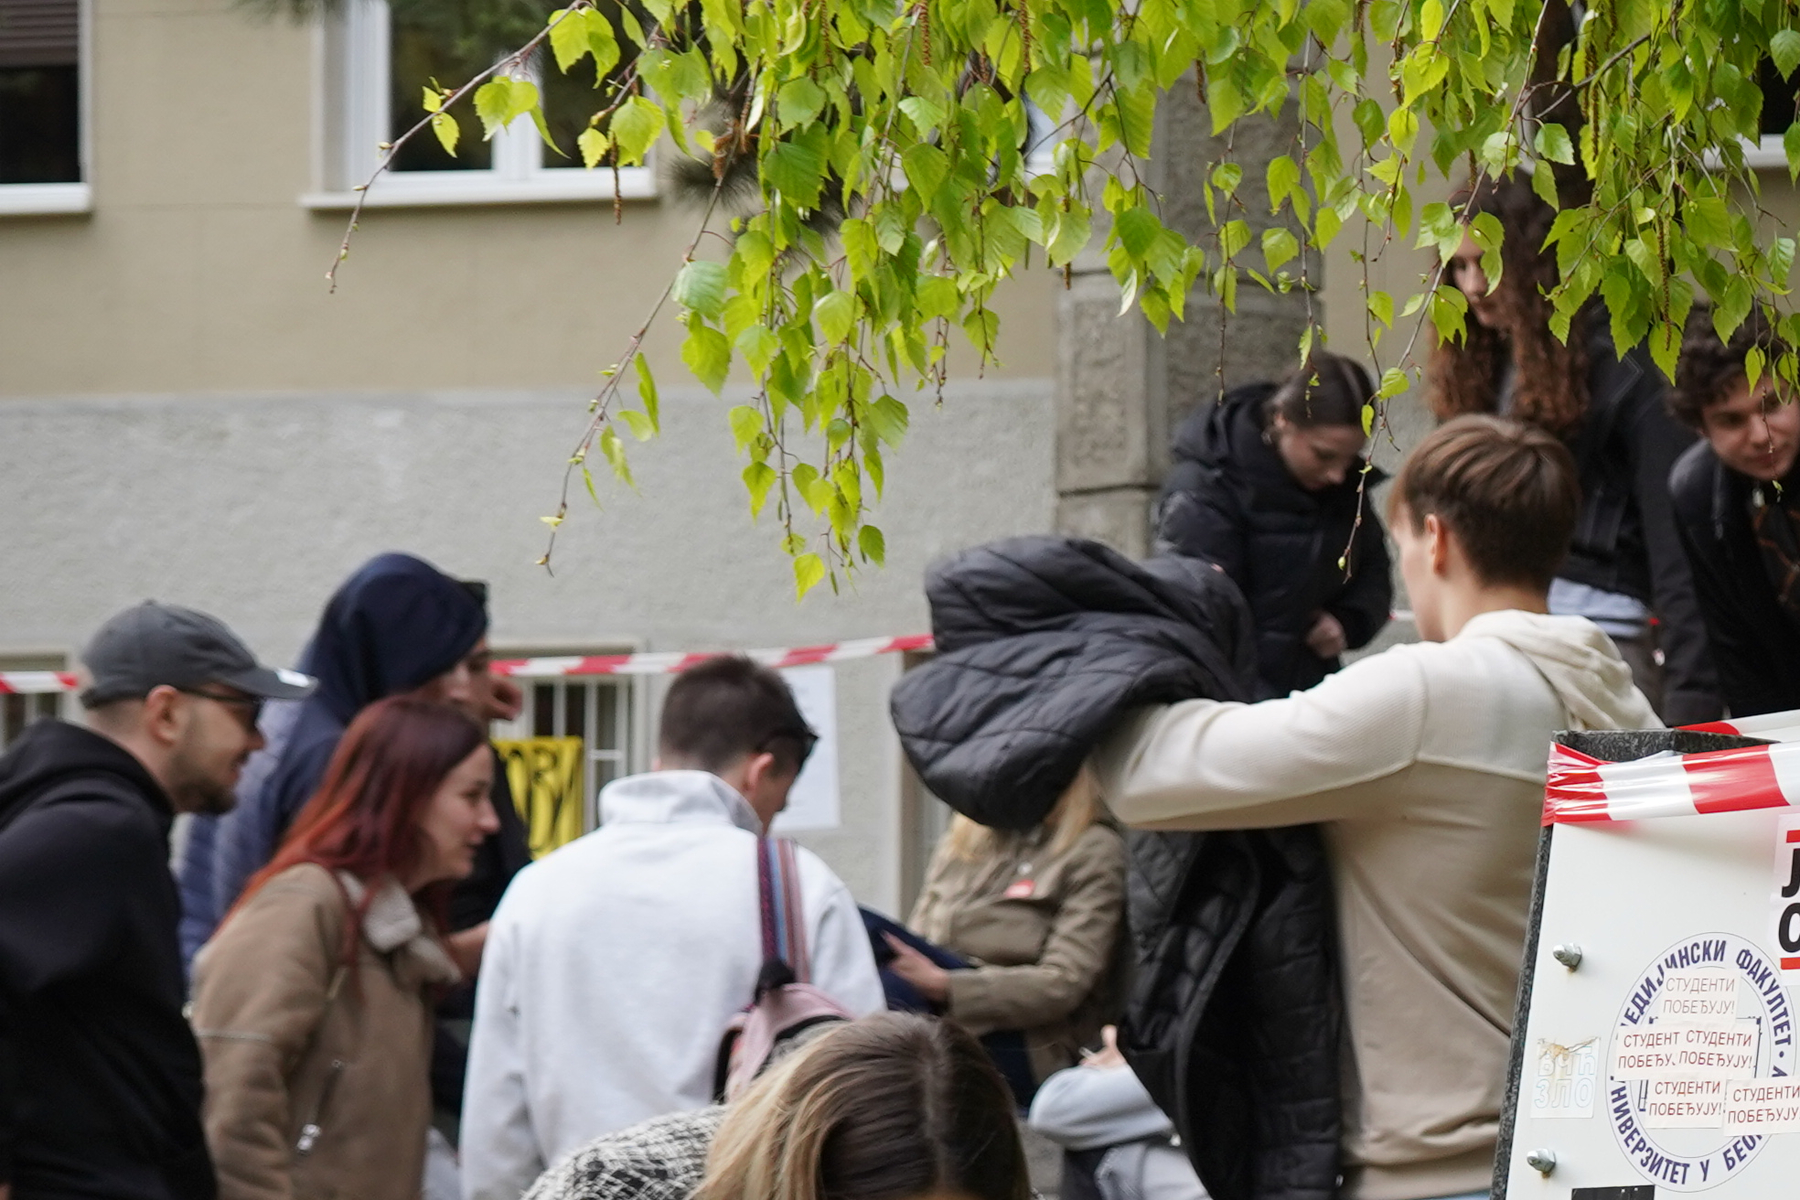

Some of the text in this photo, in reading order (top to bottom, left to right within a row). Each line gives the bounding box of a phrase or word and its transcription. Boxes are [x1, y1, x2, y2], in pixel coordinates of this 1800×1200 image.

[1620, 939, 1792, 1047] ЕДИИНСКИ ФАКУЛТЕТ
[1665, 977, 1735, 994] СТУДЕНТИ
[1663, 999, 1735, 1015] ПОБЕЂУЈУ!
[1623, 1031, 1681, 1048] СТУДЕНТ
[1685, 1029, 1752, 1048] СТУДЕНТИ
[1618, 1053, 1676, 1068] ПОБЕЂУ
[1678, 1050, 1753, 1069] ПОБЕЂУЈУ!
[1533, 1078, 1594, 1109] ЗЛО
[1654, 1080, 1721, 1096] СТУДЕНТИ
[1732, 1085, 1800, 1104] СТУДЕНТИ
[1649, 1102, 1723, 1117] ПОБЕЂУЈУ!
[1610, 1076, 1691, 1185] НИВЕРЗИТЕТ
[1699, 1158, 1711, 1183] У
